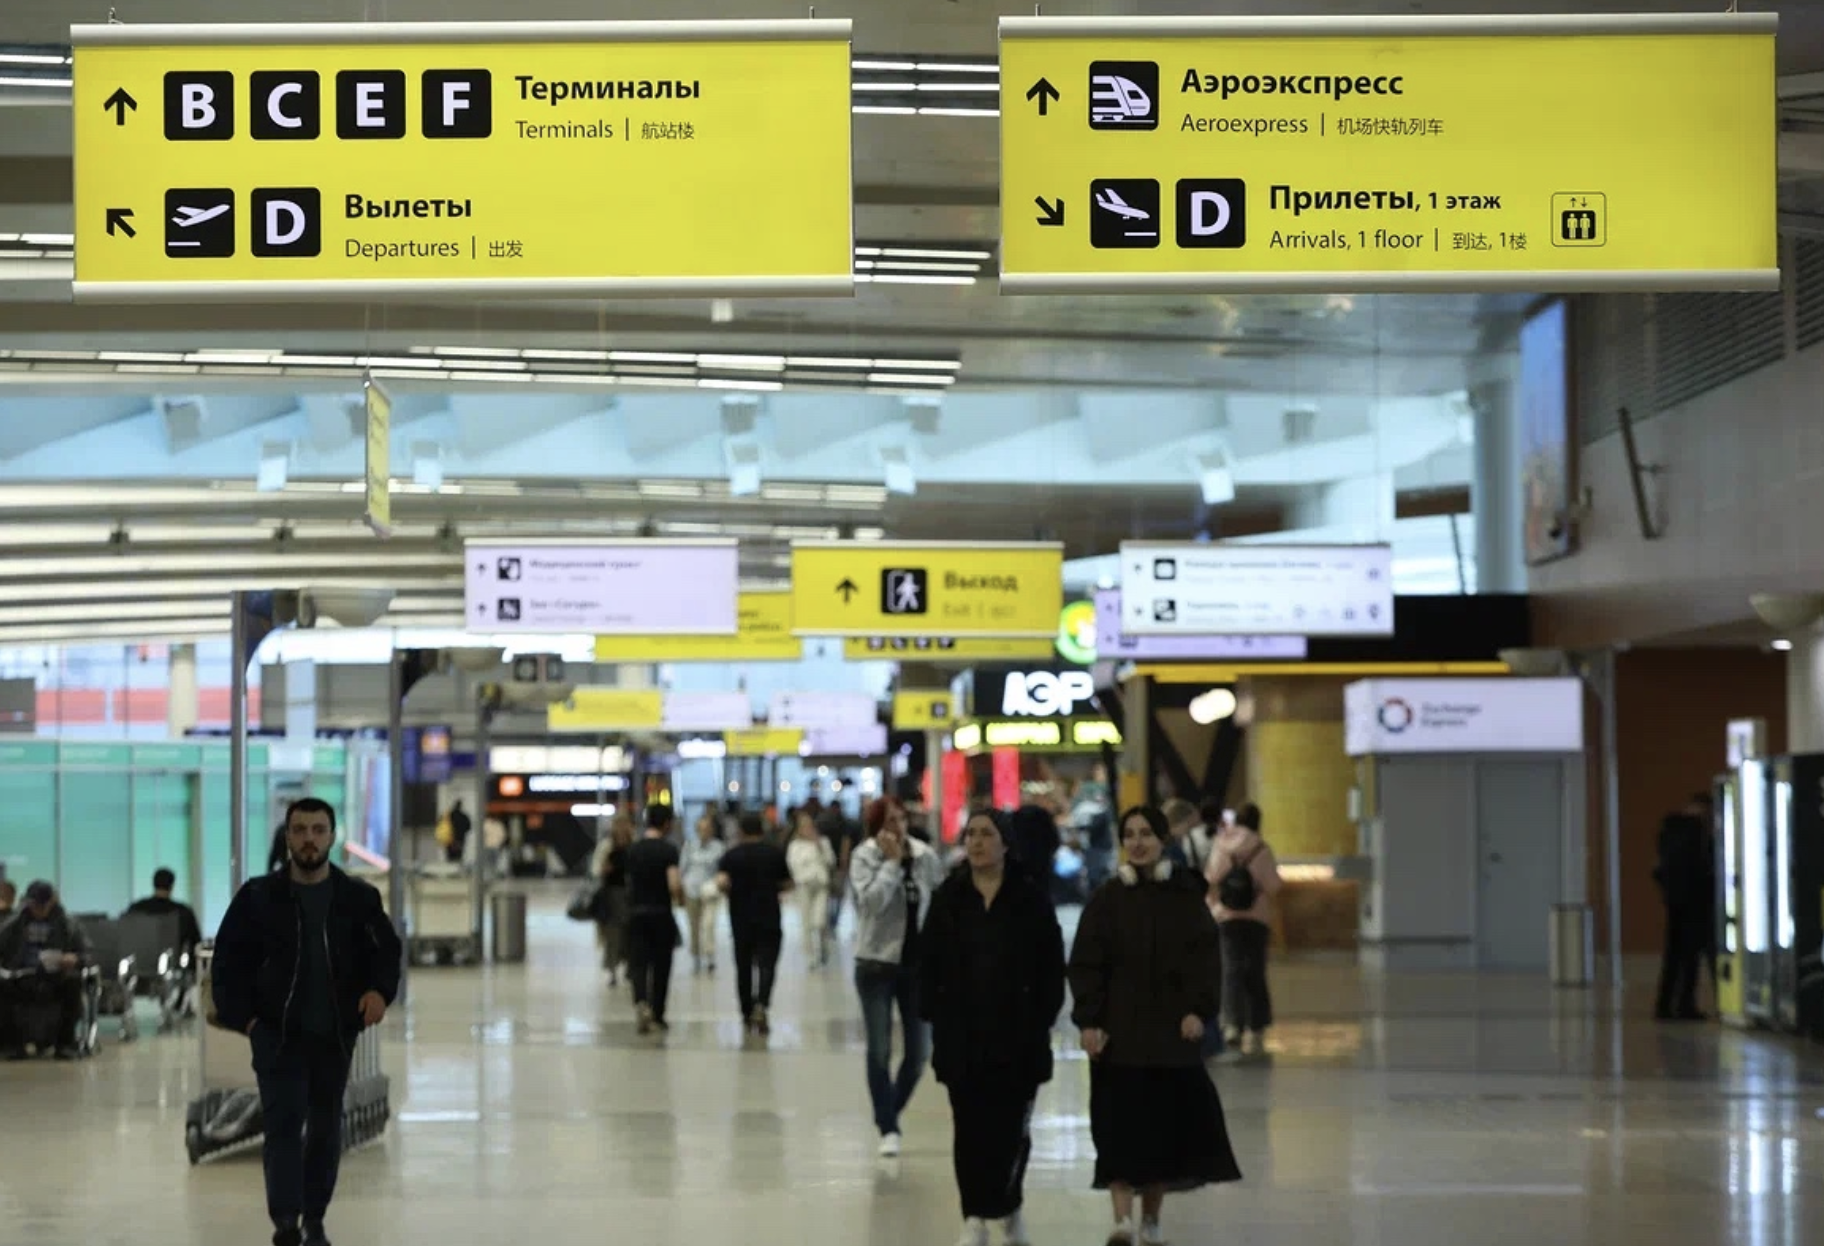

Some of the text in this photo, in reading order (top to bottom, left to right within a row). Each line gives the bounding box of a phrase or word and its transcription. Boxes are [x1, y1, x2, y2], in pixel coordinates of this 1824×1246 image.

[514, 75, 700, 107] Терминалы
[1181, 67, 1404, 101] Аэроэкспресс
[183, 82, 471, 128] B C E F
[515, 118, 614, 140] Terminals
[641, 121, 695, 140] 航站楼
[1181, 113, 1309, 138] Aeroexpress
[1336, 116, 1445, 137] 机场快轨列车
[345, 194, 472, 220] Вылеты
[1192, 191, 1230, 236] D
[1269, 184, 1502, 218] Прилеты, 1 этаж
[267, 201, 306, 245] D
[345, 238, 461, 262] Departures
[488, 239, 524, 259] 出发
[1270, 228, 1425, 251] Arrivals, 1 floor
[944, 571, 1018, 592] Выход
